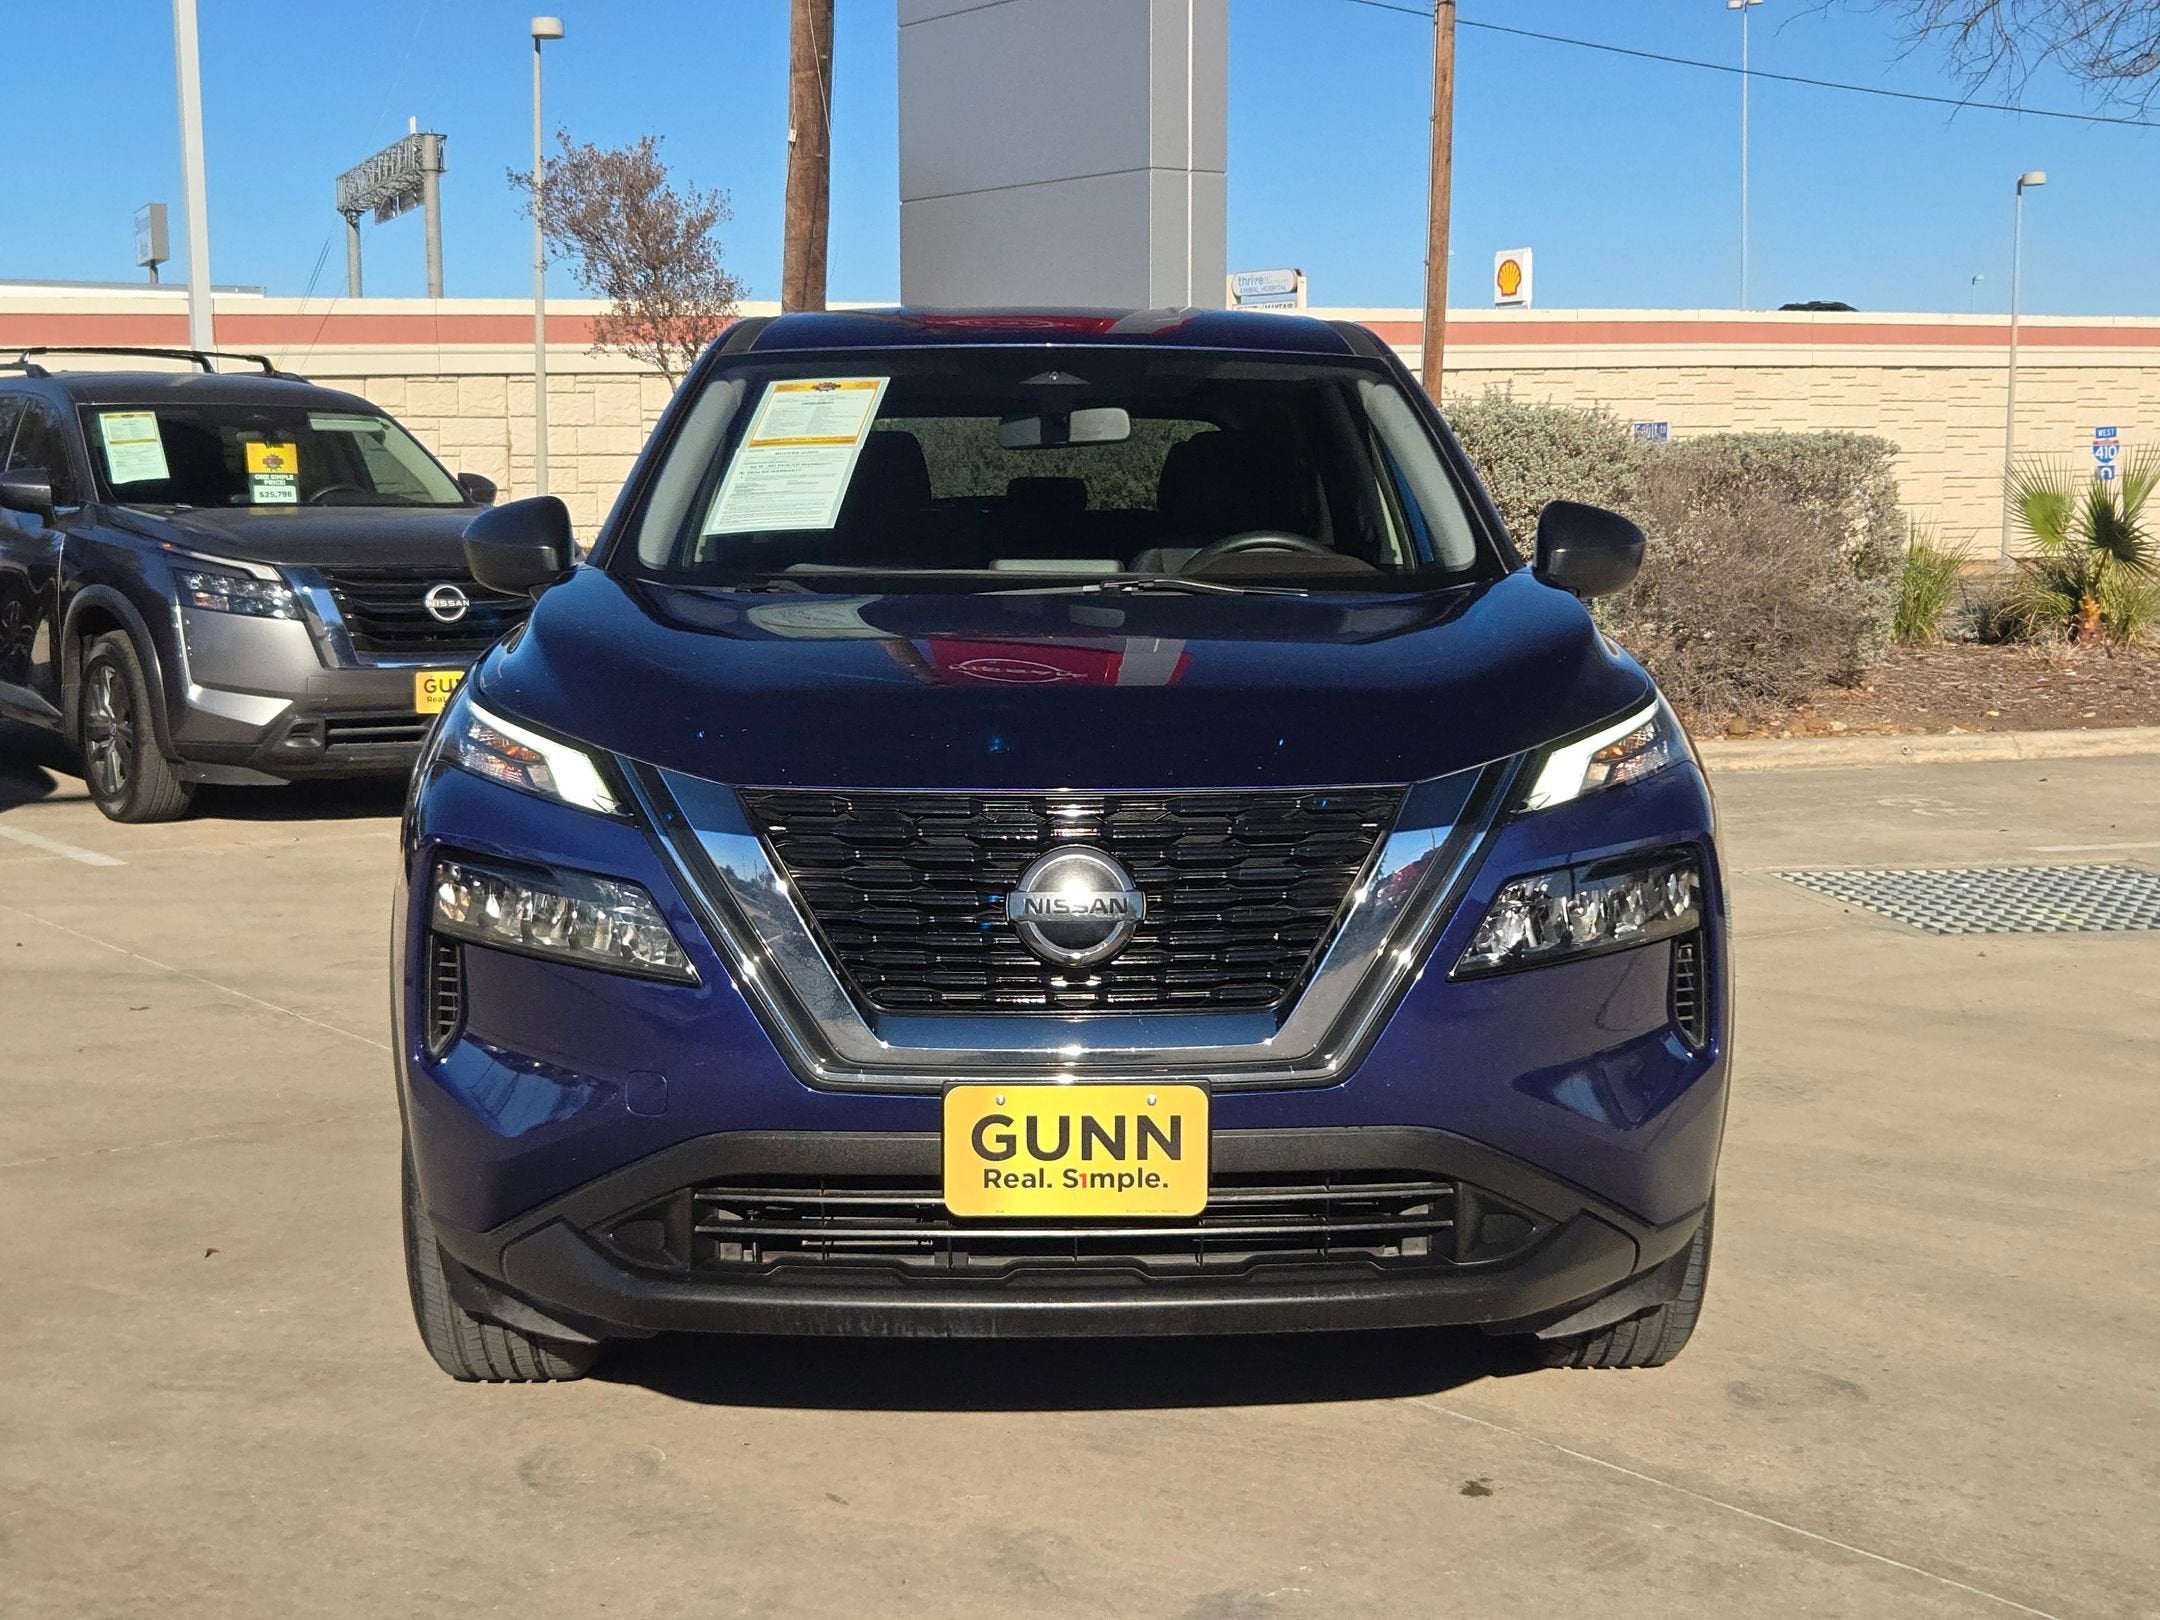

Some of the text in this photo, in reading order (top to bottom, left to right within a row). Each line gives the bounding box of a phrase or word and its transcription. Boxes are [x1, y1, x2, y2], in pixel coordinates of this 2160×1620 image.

[1238, 274, 1264, 286] thrive
[2098, 429, 2114, 437] WEST
[2095, 445, 2117, 459] 410
[426, 599, 470, 607] NISSAN
[1024, 898, 1128, 914] NISSAN
[971, 1114, 1181, 1161] GUNN
[983, 1168, 1053, 1189] Real.
